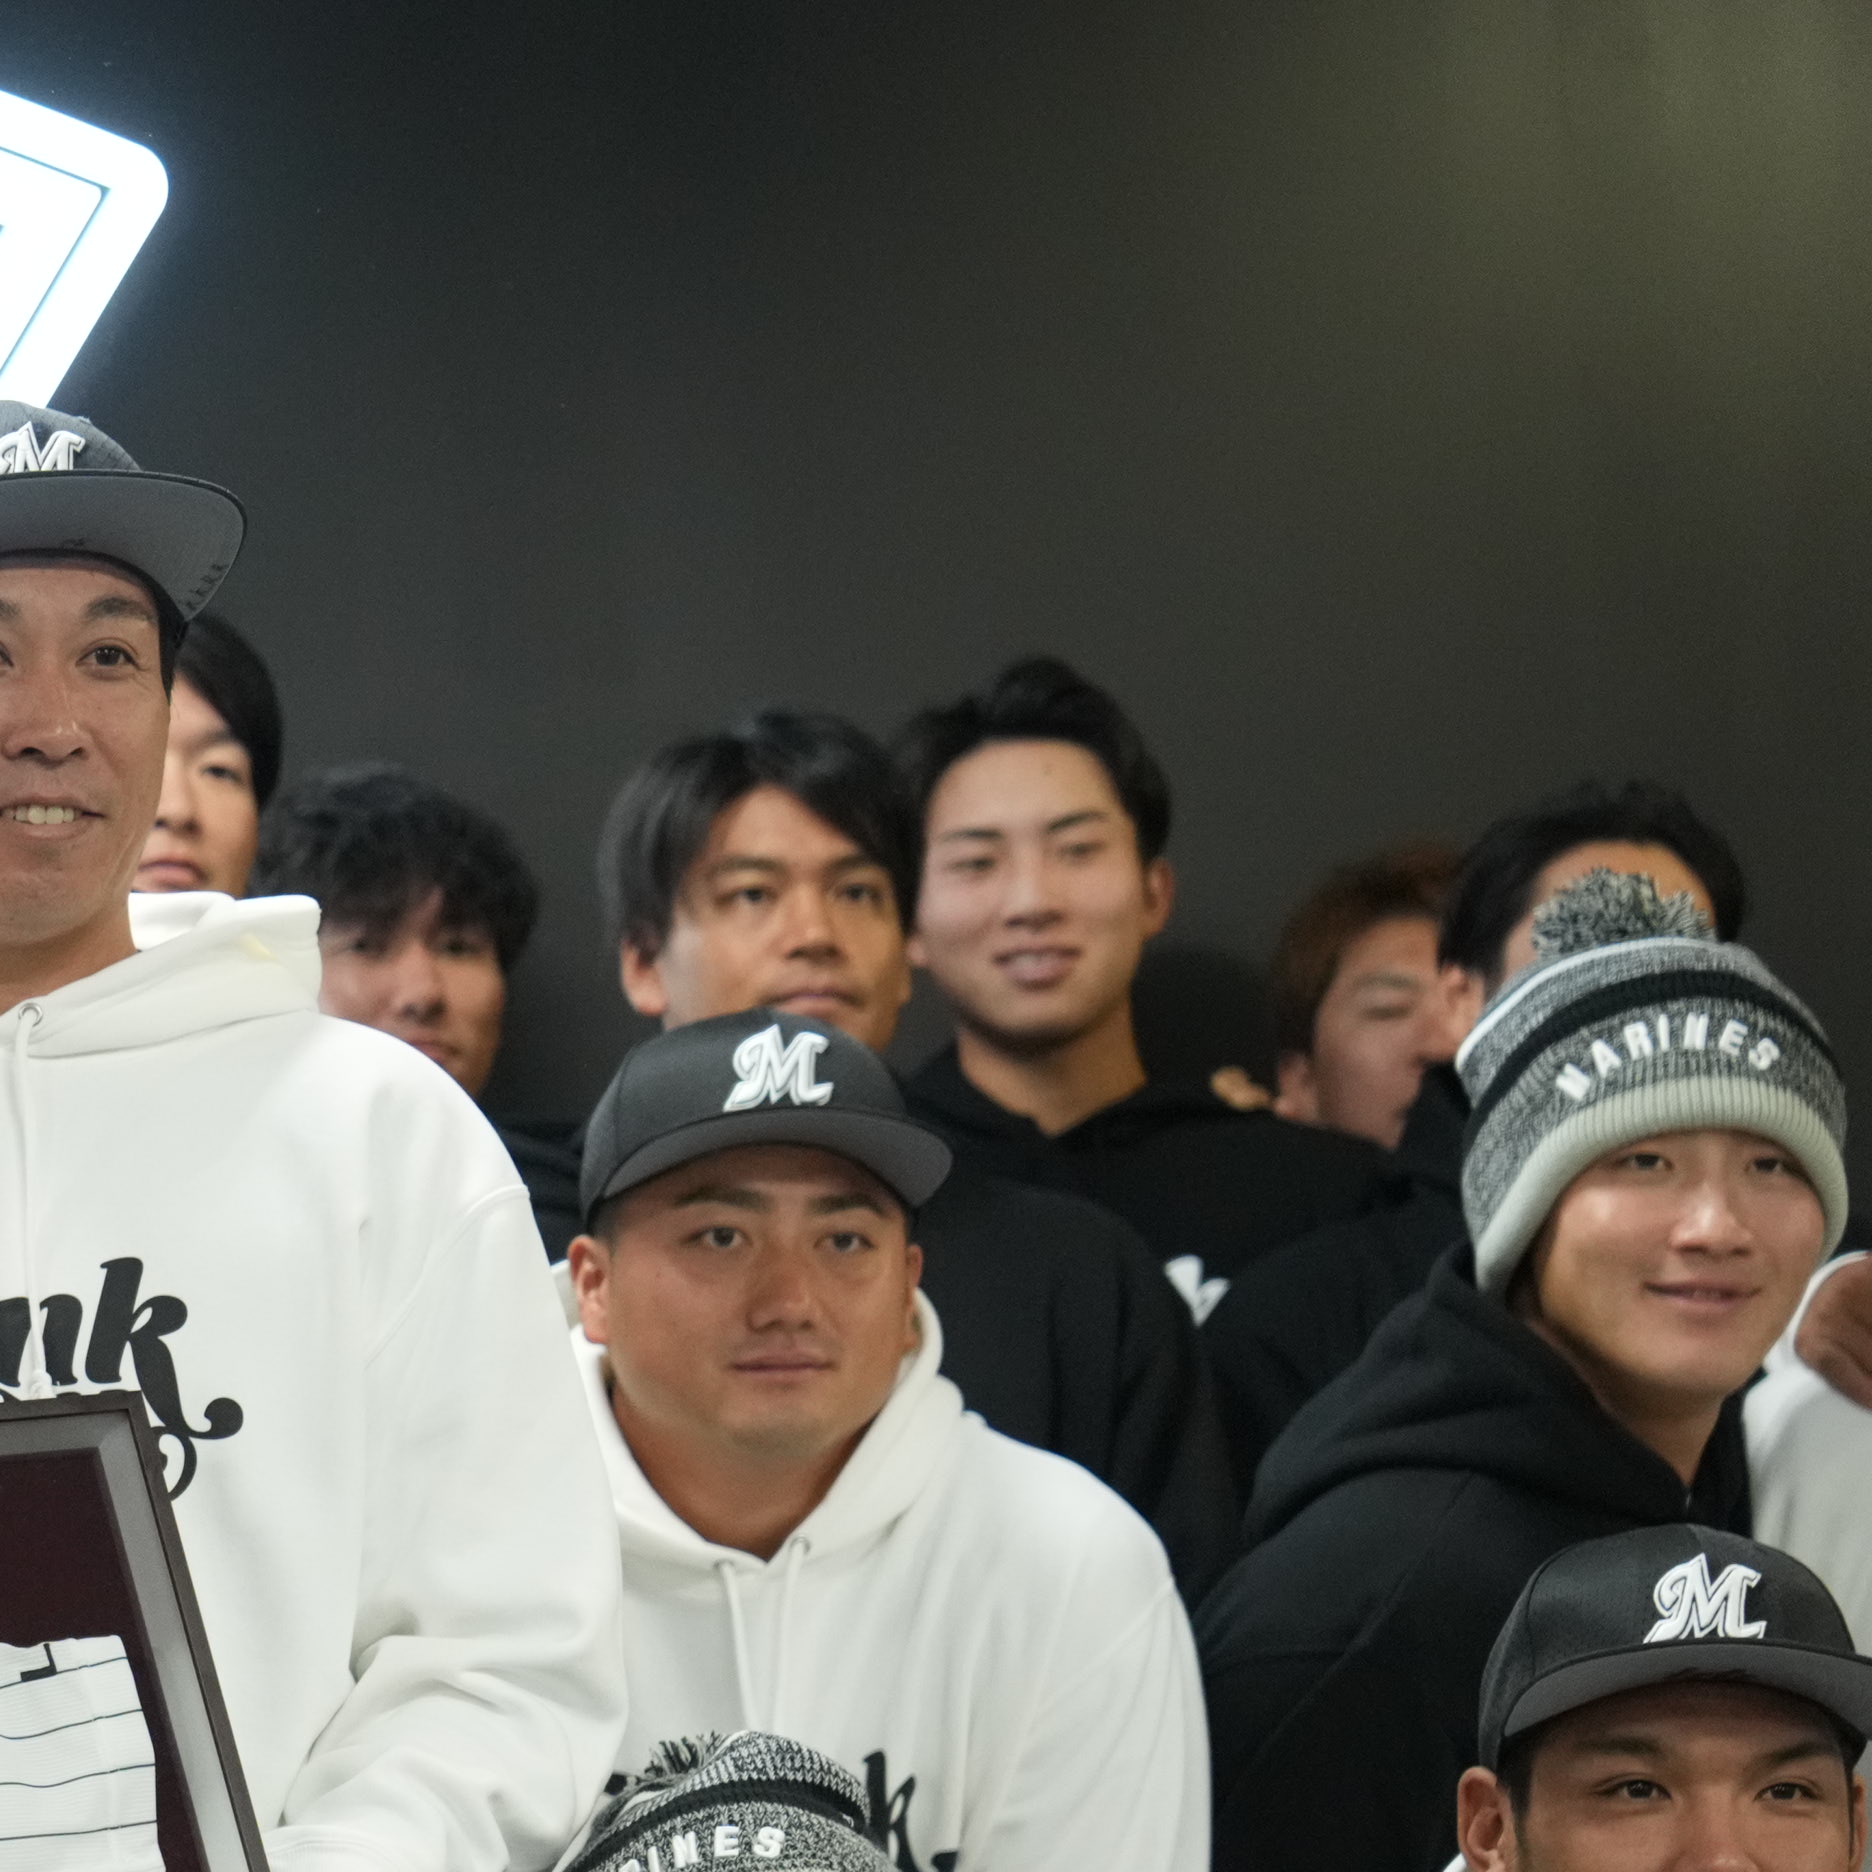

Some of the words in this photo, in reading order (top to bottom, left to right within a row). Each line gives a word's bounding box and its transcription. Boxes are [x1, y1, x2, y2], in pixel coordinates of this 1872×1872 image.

[722, 1023, 834, 1113] M
[1556, 1012, 1782, 1101] MARINES
[1642, 1552, 1767, 1644] M
